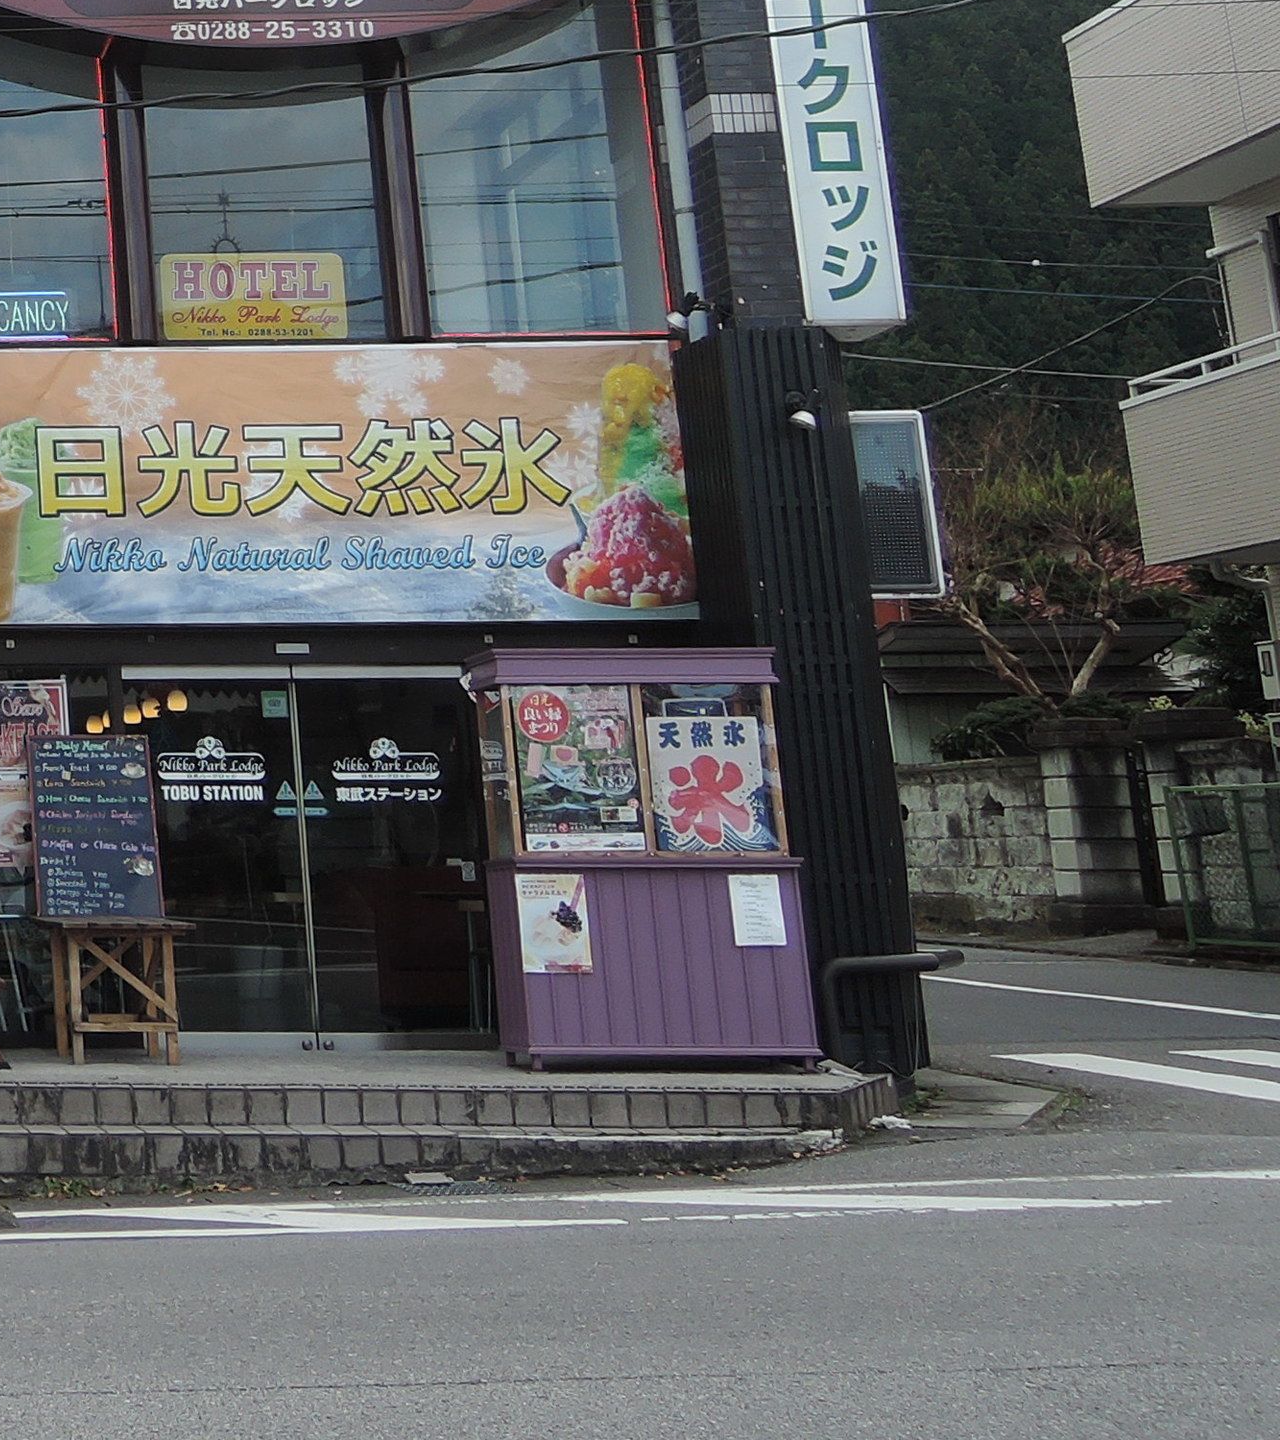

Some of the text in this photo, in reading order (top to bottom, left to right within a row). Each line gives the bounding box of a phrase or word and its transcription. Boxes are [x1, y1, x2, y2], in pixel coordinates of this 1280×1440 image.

[197, 18, 374, 40] 0288-25-3310
[172, 261, 331, 301] HOTEL
[172, 305, 339, 328] Nikko Park Lodge
[35, 418, 571, 518] 日光天然氷
[53, 533, 548, 574] Nikko Natural Shaved Ice
[529, 723, 559, 734] まつり
[160, 759, 265, 775] Nikko Park Lodge
[333, 759, 439, 775] Nikko Park Lodge
[161, 785, 264, 801] TOBU STATION
[335, 788, 442, 802] 東武ステーション
[668, 755, 750, 845] 氷
